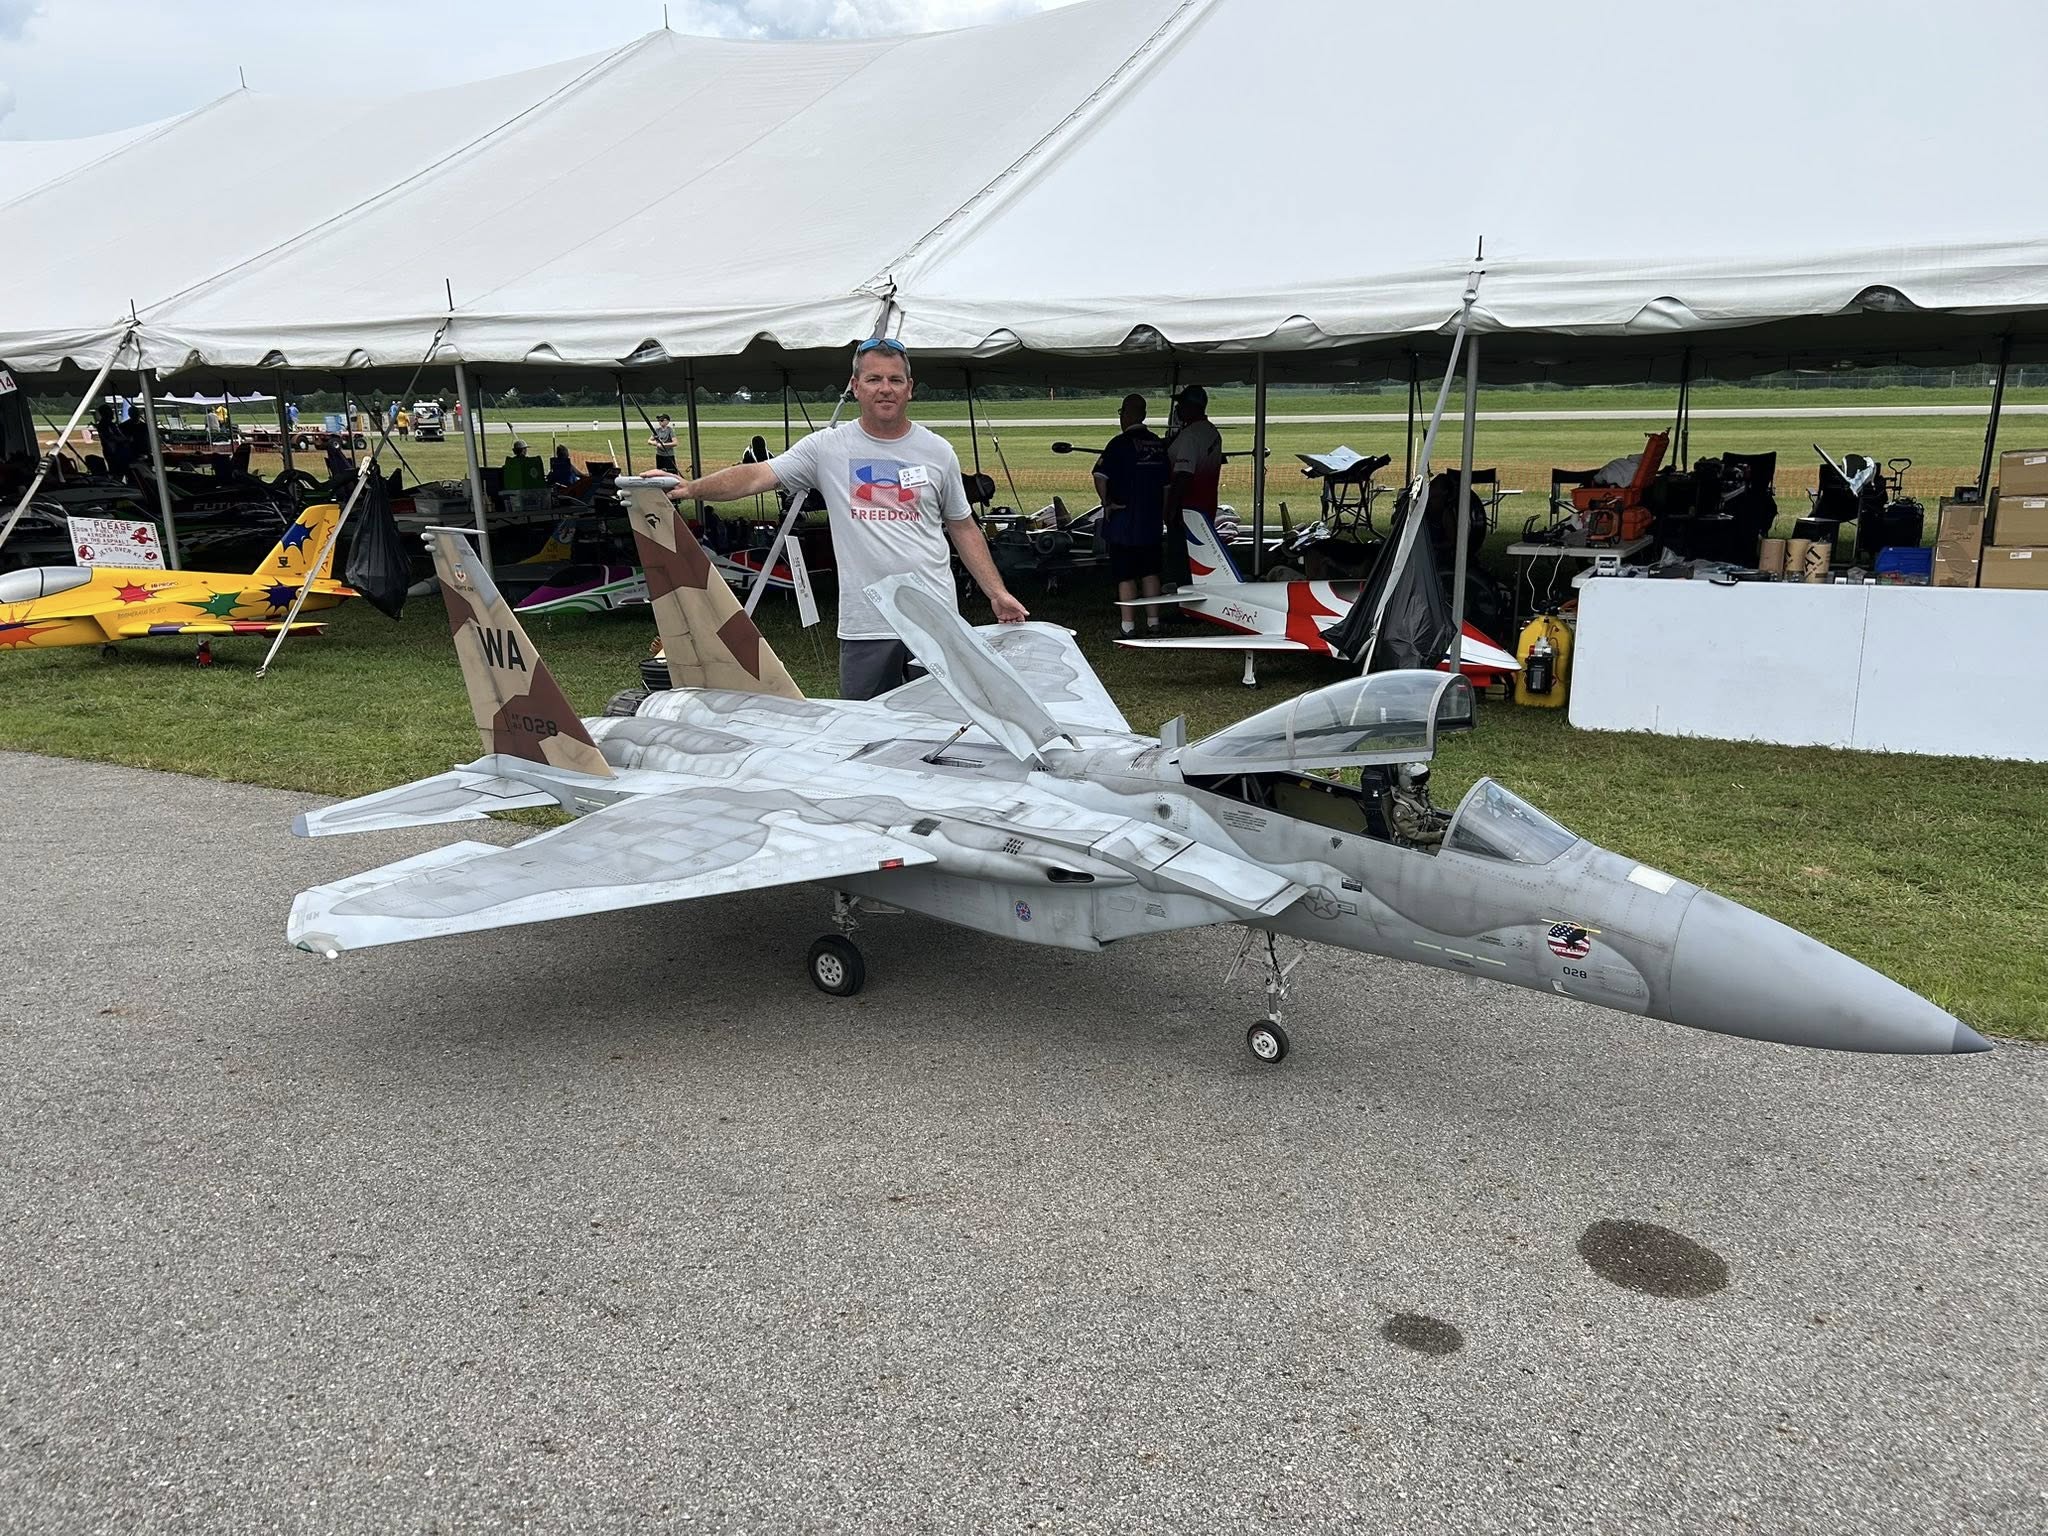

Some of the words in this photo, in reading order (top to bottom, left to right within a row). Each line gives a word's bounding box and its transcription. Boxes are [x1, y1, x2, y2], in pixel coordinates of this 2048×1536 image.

[851, 509, 920, 521] FREEDOM
[94, 521, 132, 531] PLEASE
[99, 547, 113, 557] JETS
[477, 626, 527, 672] WA
[522, 716, 558, 736] 028
[1563, 966, 1587, 979] 028
